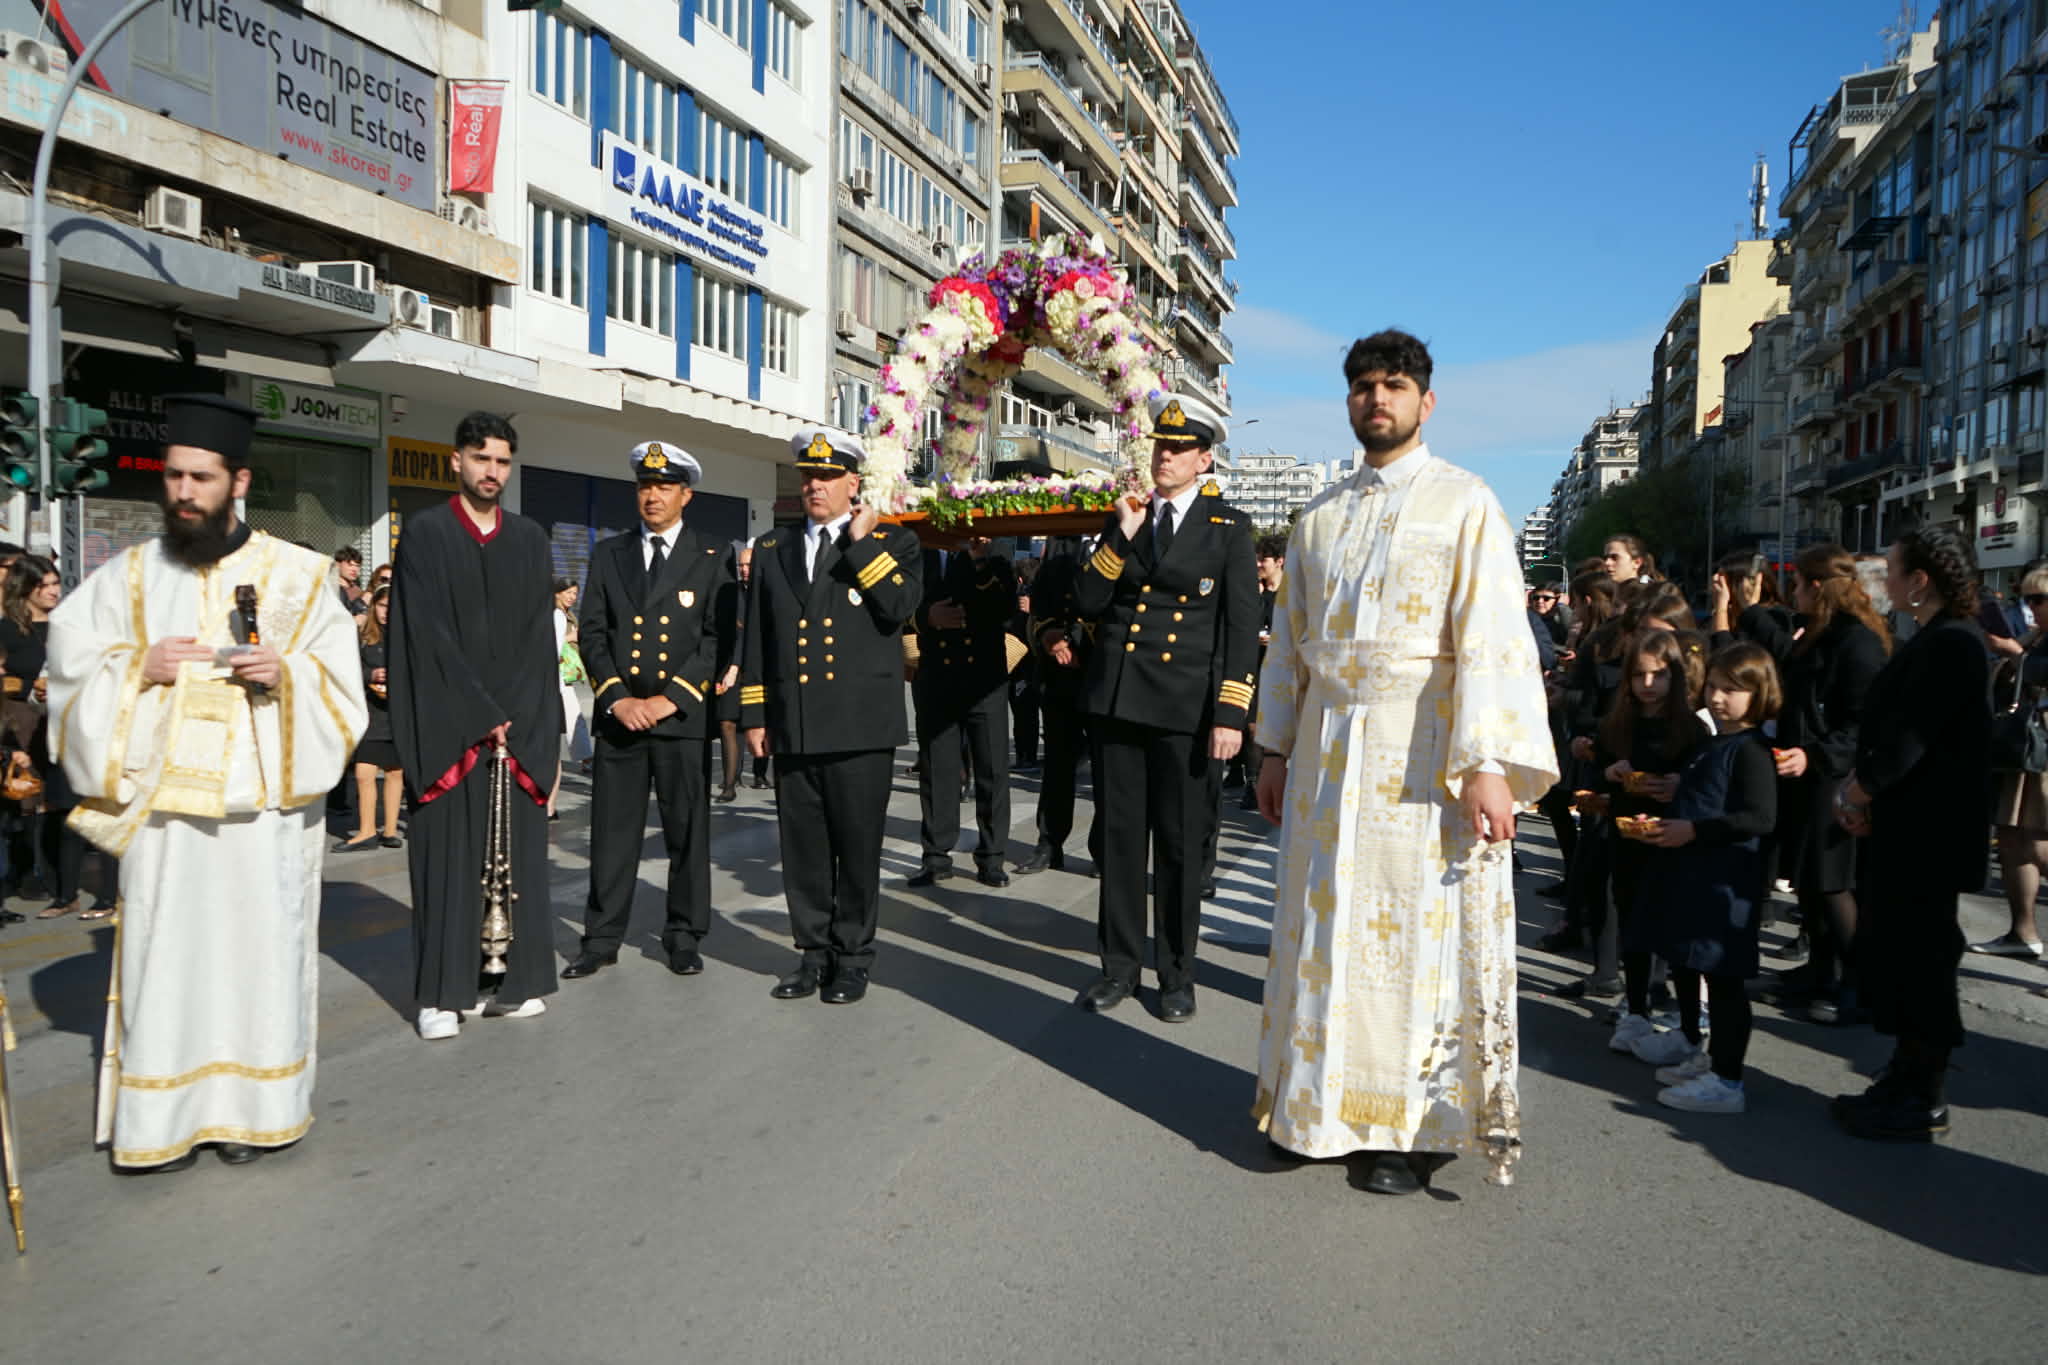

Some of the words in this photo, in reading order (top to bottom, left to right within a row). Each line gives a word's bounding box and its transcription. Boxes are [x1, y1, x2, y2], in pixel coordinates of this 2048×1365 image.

[277, 71, 337, 128] Real
[351, 104, 426, 163] Estate
[292, 39, 426, 128] υπηρεσίες
[280, 127, 414, 192] www.skoreal.gr
